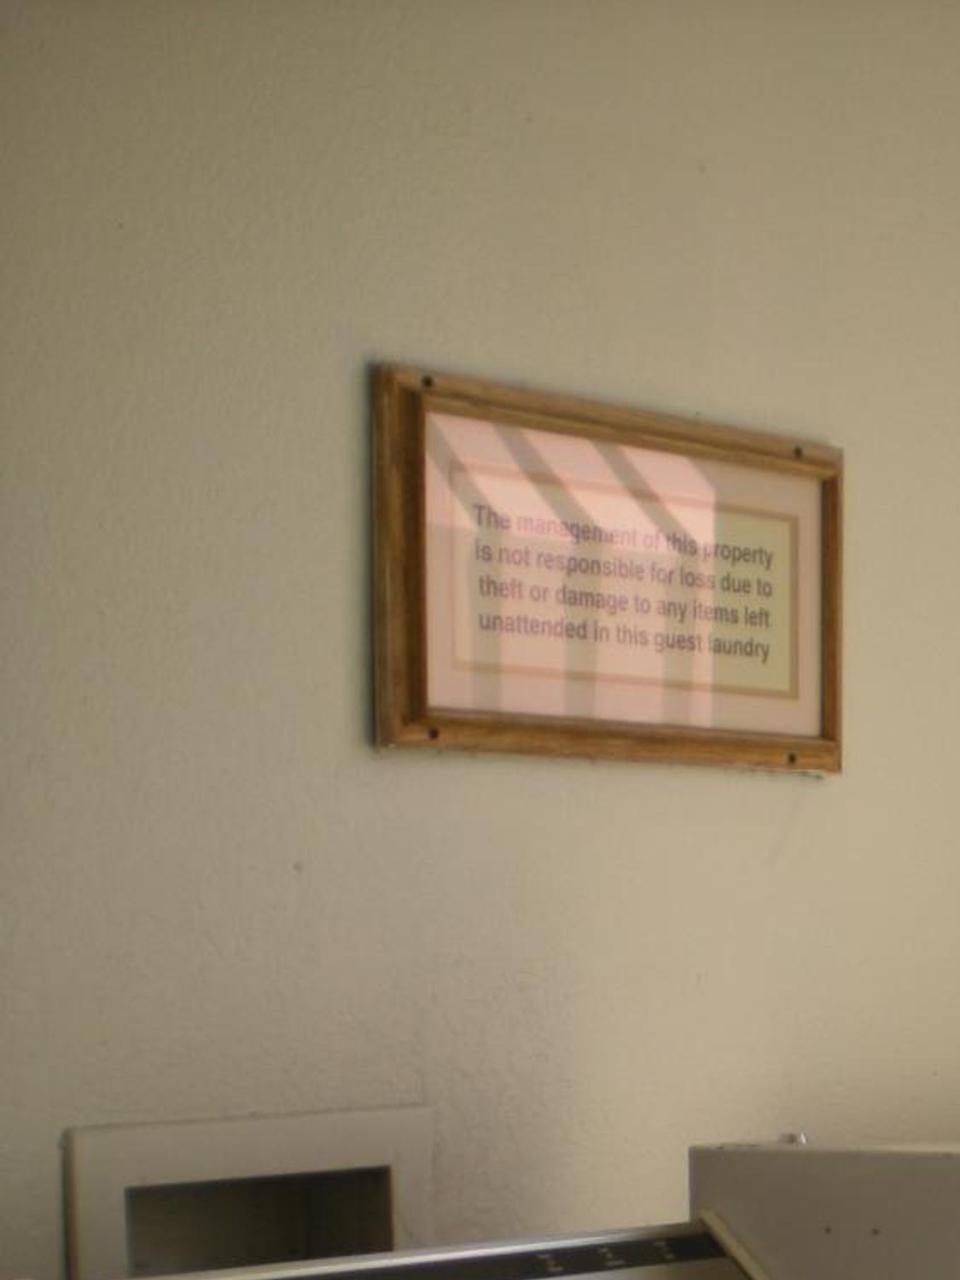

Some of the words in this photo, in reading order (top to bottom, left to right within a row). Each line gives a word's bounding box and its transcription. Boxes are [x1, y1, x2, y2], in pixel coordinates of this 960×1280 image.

[473, 503, 511, 530] The
[516, 515, 638, 547] management
[642, 532, 660, 549] of
[665, 532, 698, 556] this
[702, 541, 774, 571] property
[475, 538, 493, 563] is
[498, 546, 531, 566] not
[536, 551, 645, 580] responsible
[649, 561, 675, 584] for
[680, 566, 716, 590] loss
[721, 572, 752, 595] due
[756, 578, 773, 597] to
[478, 574, 523, 600] theft
[529, 585, 550, 602] or
[555, 583, 630, 615] damage
[634, 595, 651, 614] to
[656, 600, 687, 624] any
[692, 599, 739, 625] items
[745, 605, 770, 628] left
[478, 612, 588, 641] unattended
[593, 620, 610, 643] in
[615, 624, 649, 647] this
[654, 632, 702, 654] guest
[707, 634, 770, 664] laundry
